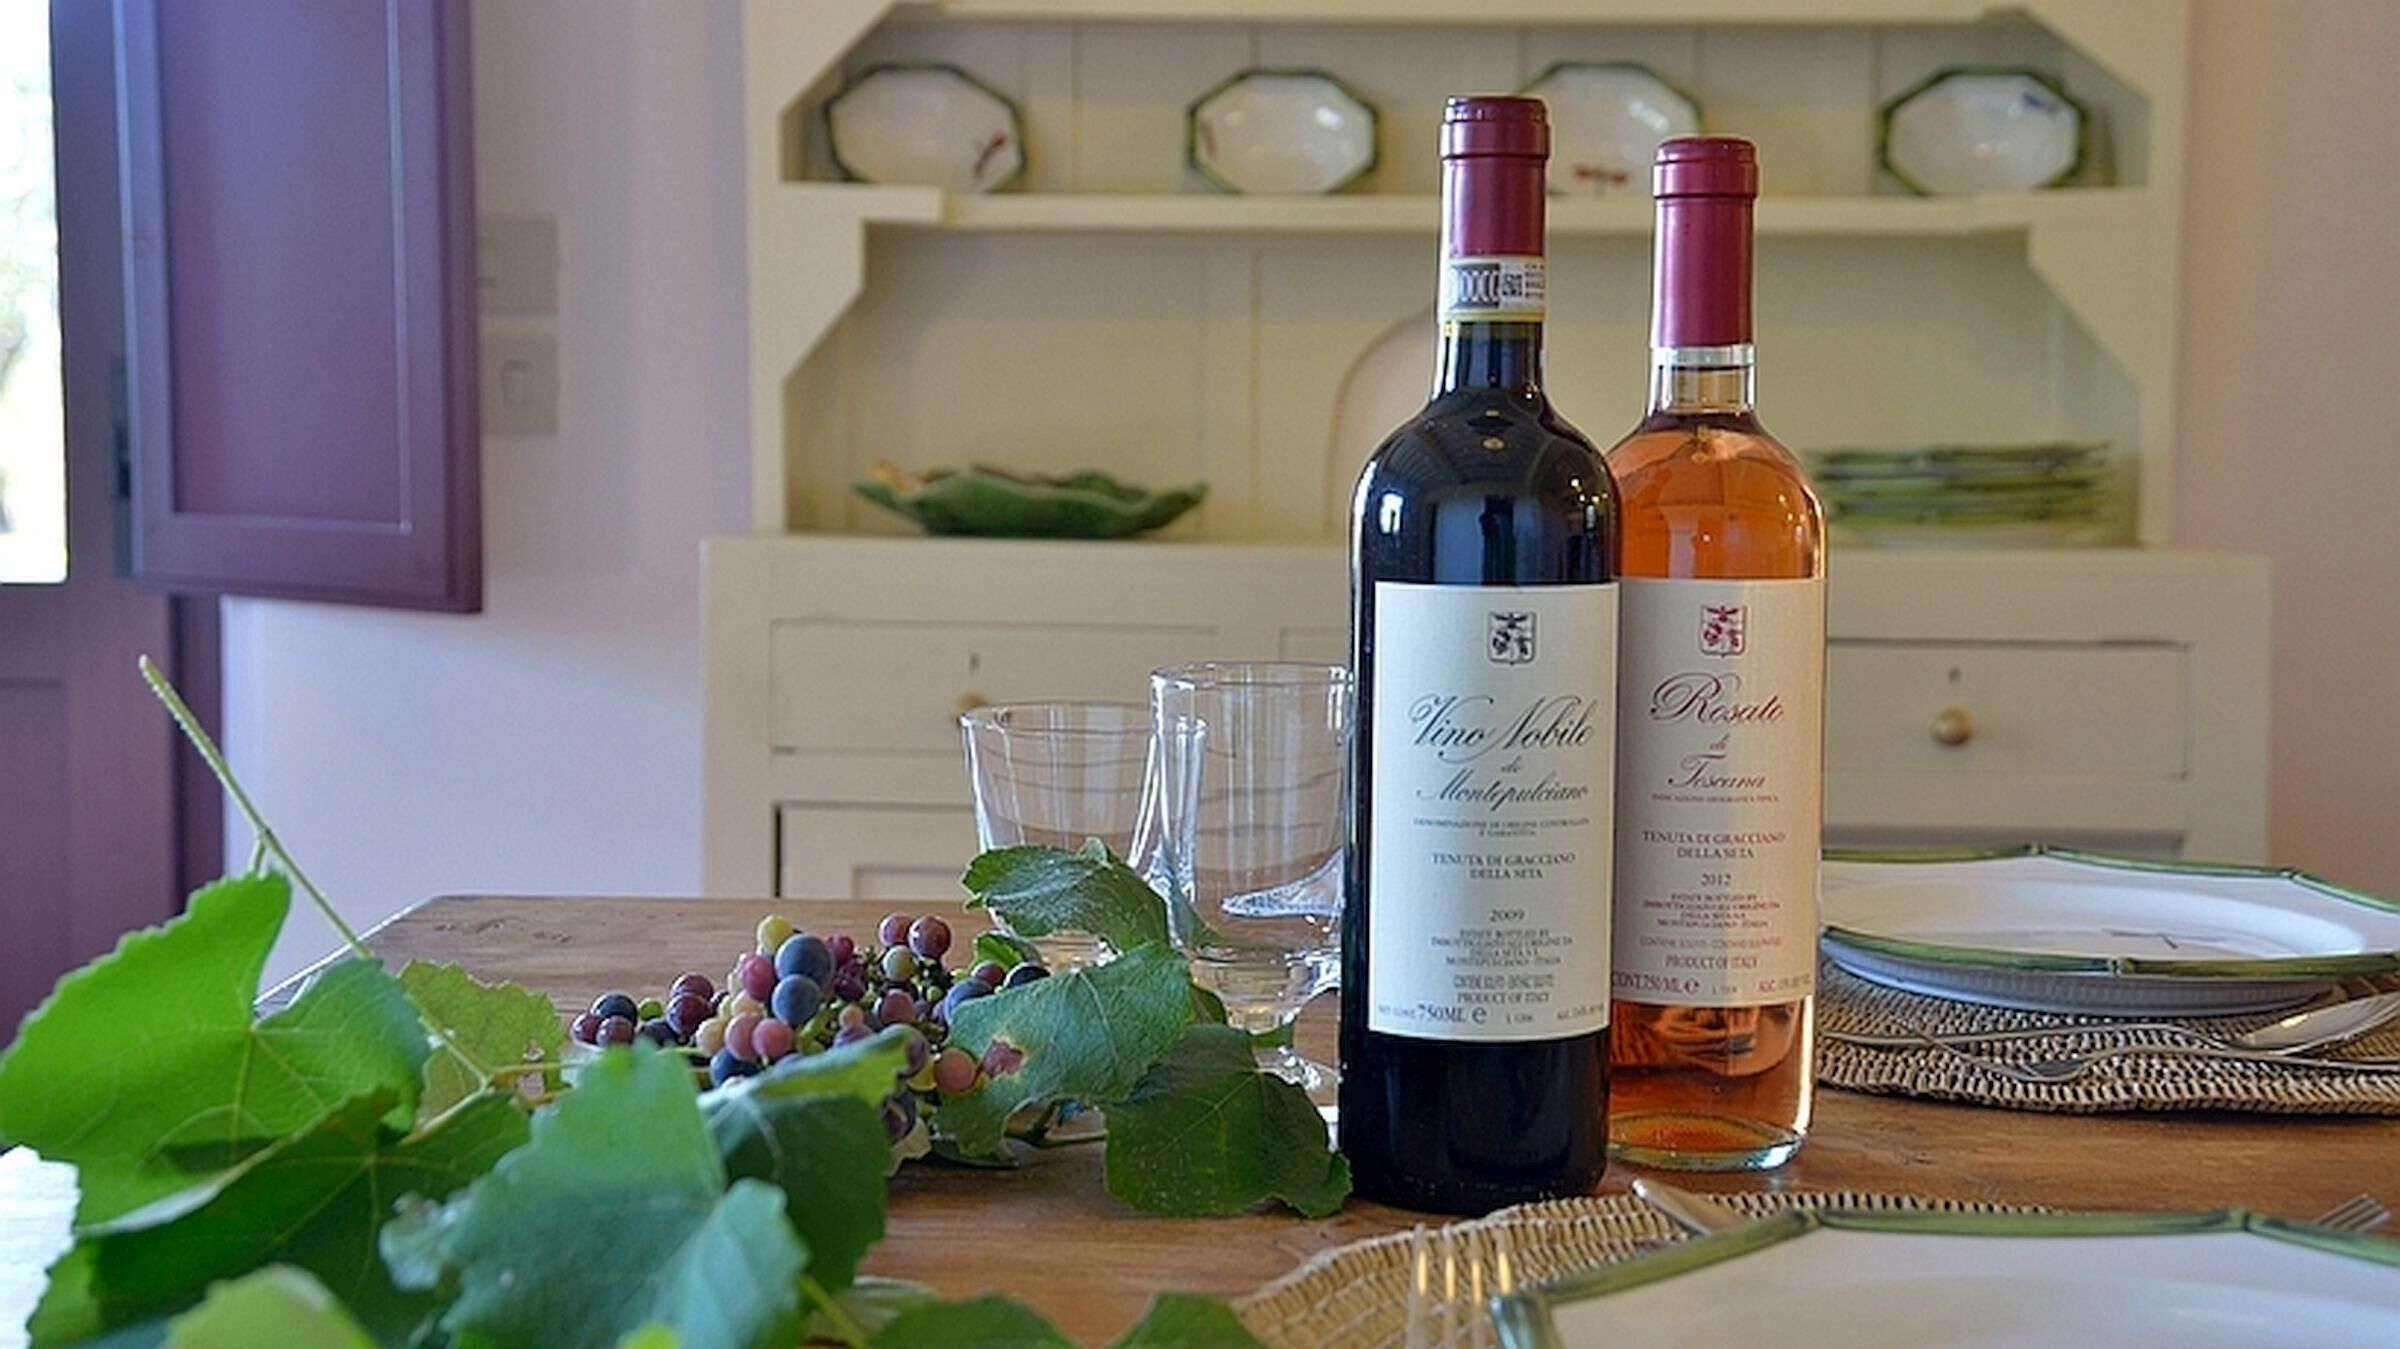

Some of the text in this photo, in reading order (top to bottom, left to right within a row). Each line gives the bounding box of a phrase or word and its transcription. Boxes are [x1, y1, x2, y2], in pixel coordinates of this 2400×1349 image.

[1650, 672, 1784, 726] Rosato
[1408, 693, 1598, 765] Vino Nobile
[1708, 733, 1730, 750] di
[1501, 755, 1523, 773] di
[1668, 754, 1766, 789] Toscana
[1416, 768, 1588, 812] Montepulciano
[1643, 830, 1786, 845] TENUTA DI GRACCIANO
[1432, 853, 1577, 867] TENUTA DI GRACCIANO
[1676, 847, 1755, 860] DELLA SETA
[1470, 868, 1544, 881] DELLA SETA
[1700, 872, 1732, 887] 2012
[1489, 908, 1527, 924] 2009
[1665, 954, 1758, 969] PRODUCT OF ITALY
[1457, 991, 1550, 1005] PRODUCT OF ITALY
[1417, 1004, 1467, 1024] 750ML
